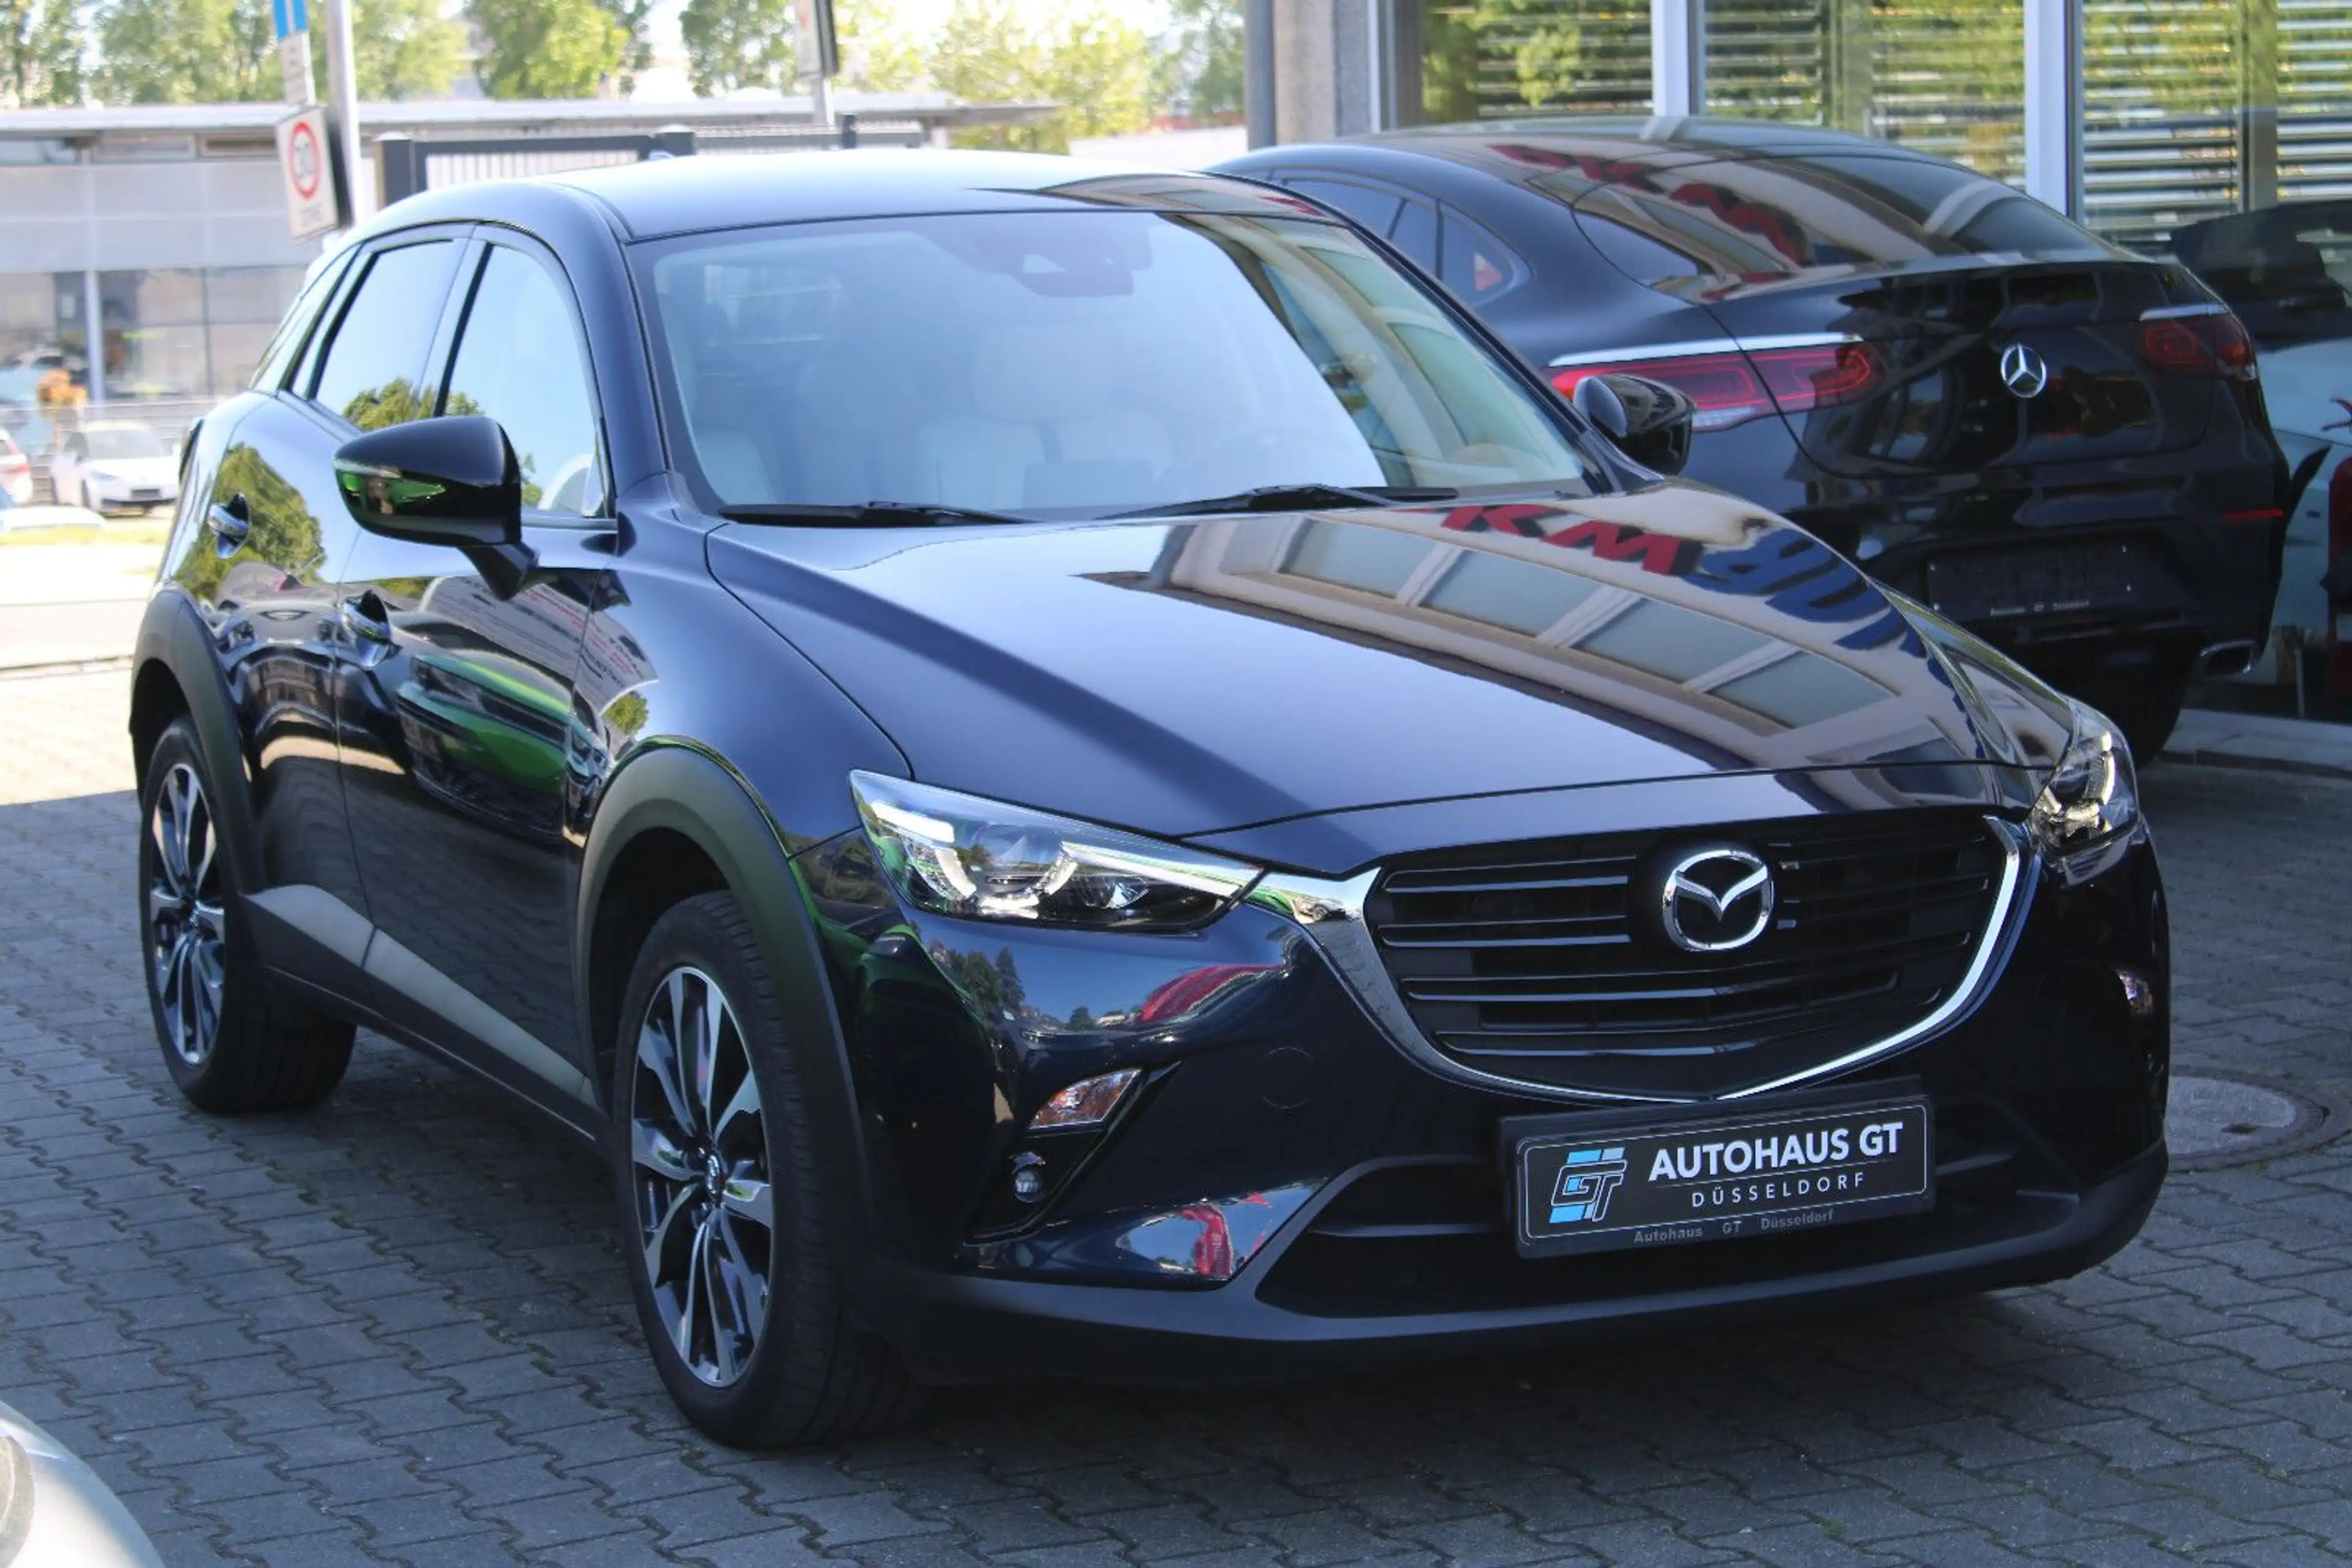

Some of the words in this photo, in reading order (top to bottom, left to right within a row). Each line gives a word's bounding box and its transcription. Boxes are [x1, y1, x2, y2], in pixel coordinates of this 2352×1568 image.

[1648, 1128, 1850, 1183] AUTOHAUS
[1859, 1121, 1904, 1157] GT
[1692, 1172, 1864, 1208] DÜSSELDORF
[1634, 1226, 1703, 1243] Autohaus
[1722, 1220, 1743, 1235] GT
[1760, 1208, 1834, 1231] Düsseldorf
